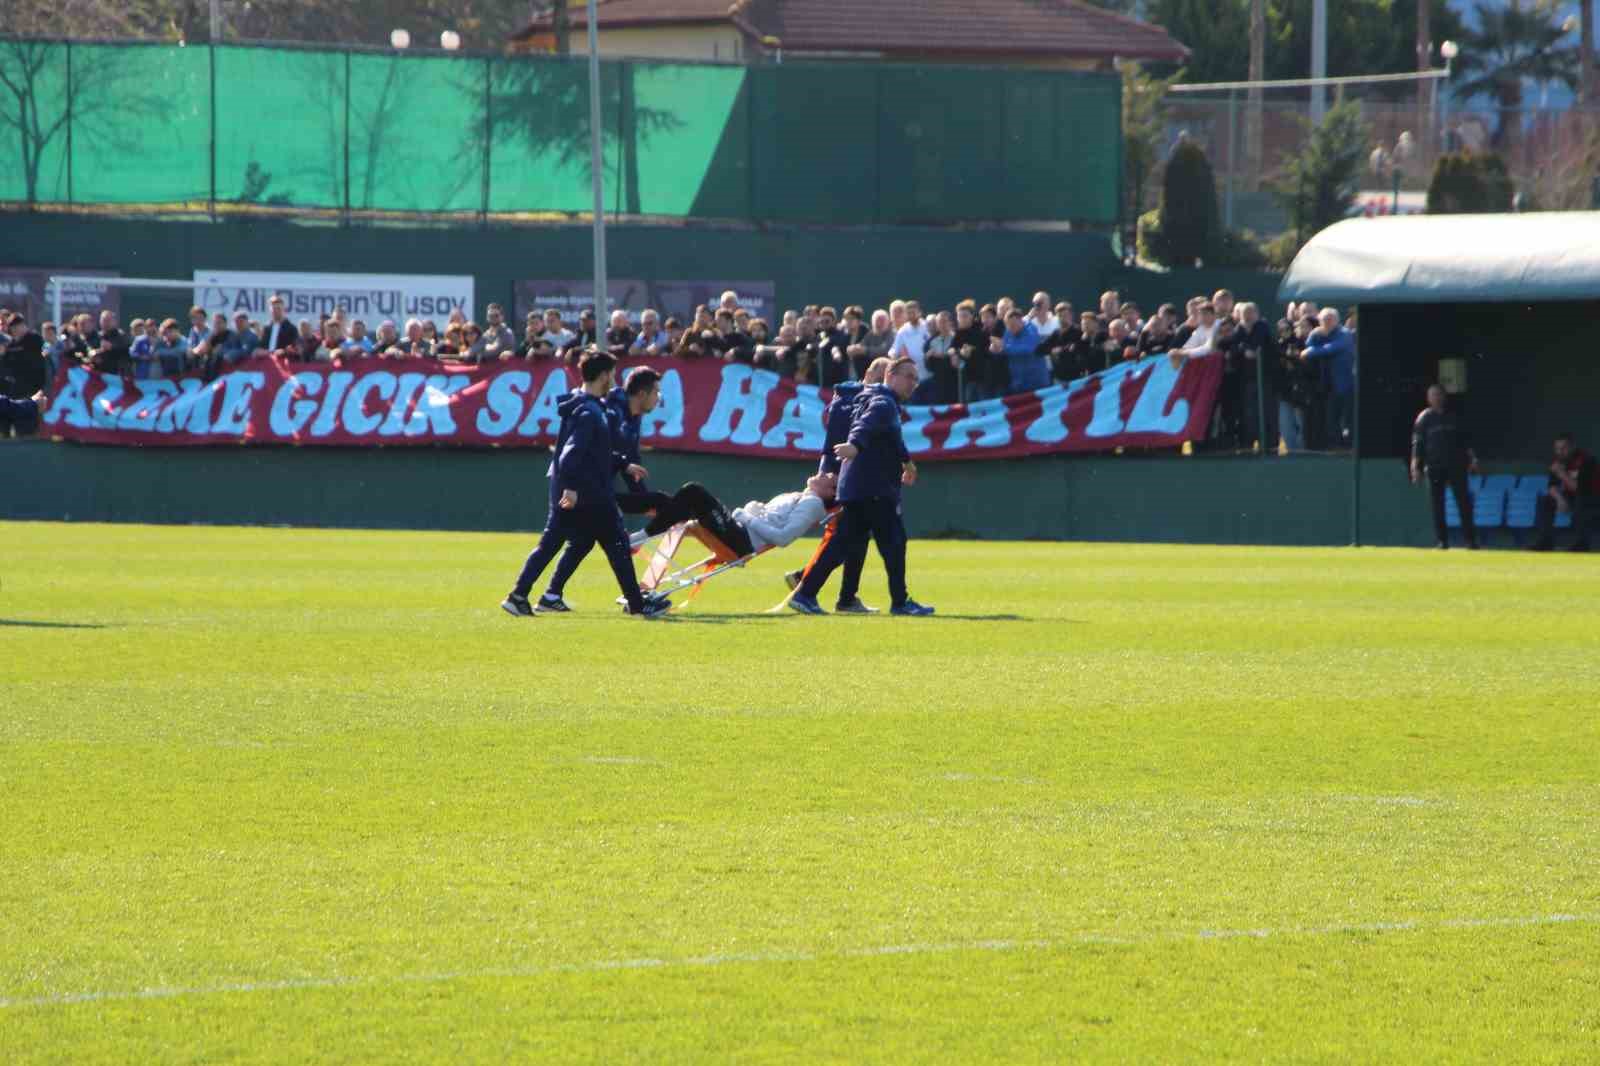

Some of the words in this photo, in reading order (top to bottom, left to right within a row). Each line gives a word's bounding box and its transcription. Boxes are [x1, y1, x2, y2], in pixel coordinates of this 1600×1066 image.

[233, 288, 265, 312] Ali
[43, 367, 265, 434] ALEME
[269, 370, 470, 437] GICIK
[476, 367, 684, 438] SAA
[698, 351, 1190, 453] HATAYIZ
